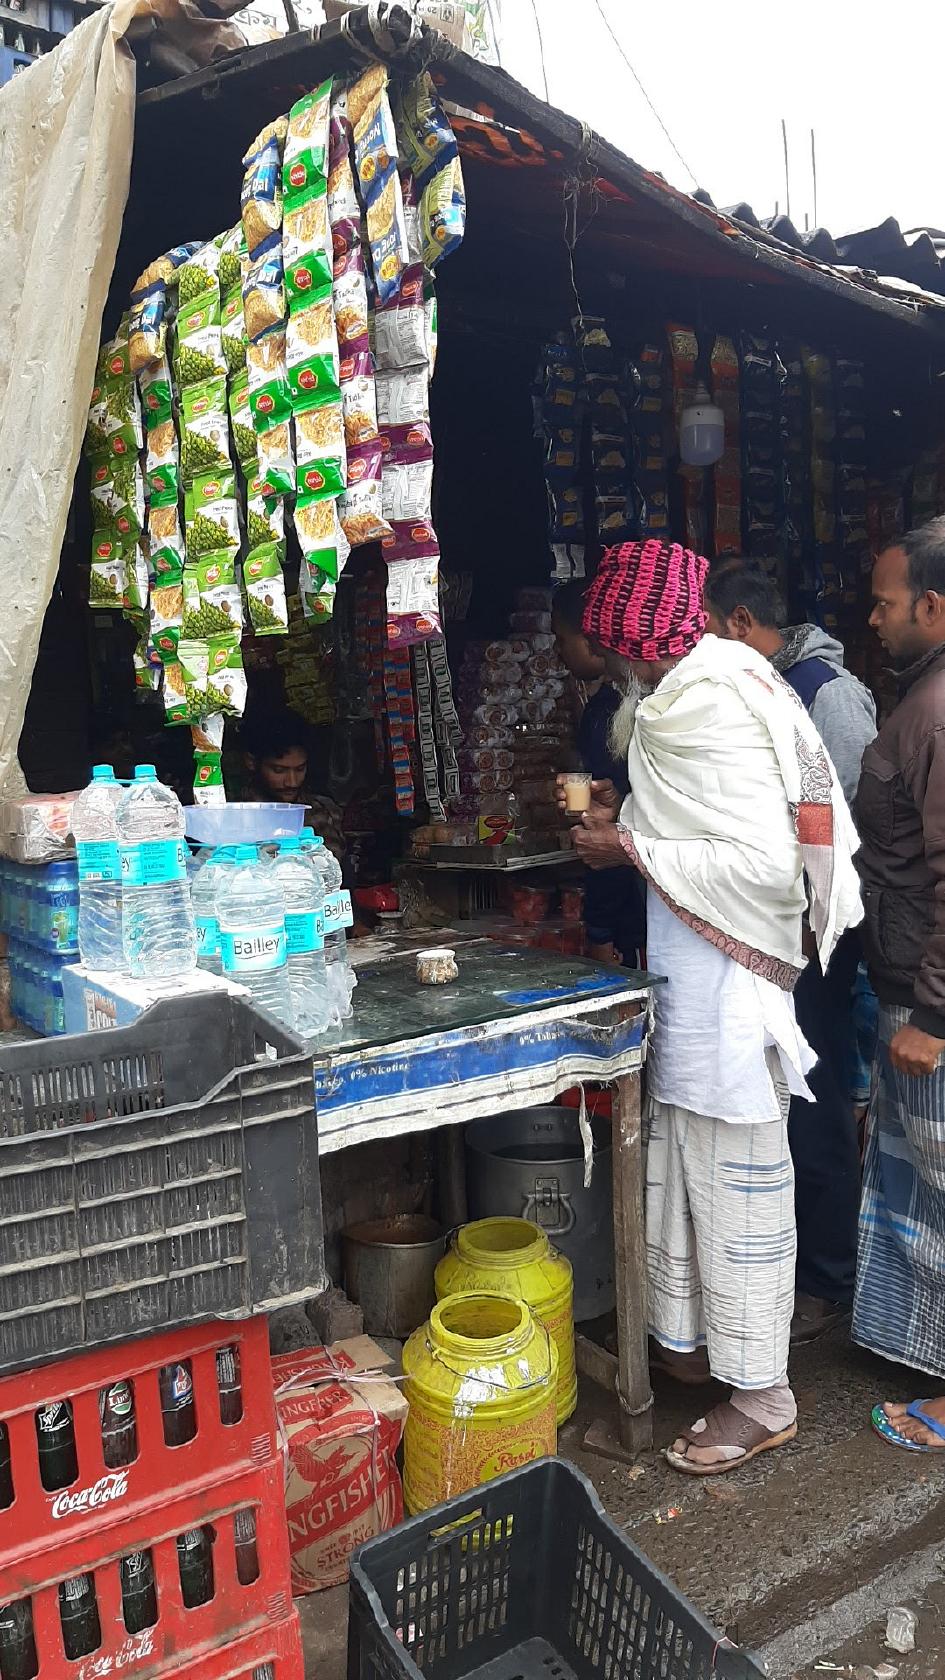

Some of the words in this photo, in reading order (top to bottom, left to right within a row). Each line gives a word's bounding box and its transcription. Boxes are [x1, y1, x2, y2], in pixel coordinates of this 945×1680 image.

[233, 936, 280, 955] Bailley
[350, 1067, 367, 1080] 0%
[369, 1061, 411, 1076] Nicotine
[317, 1526, 375, 1569] STRONG
